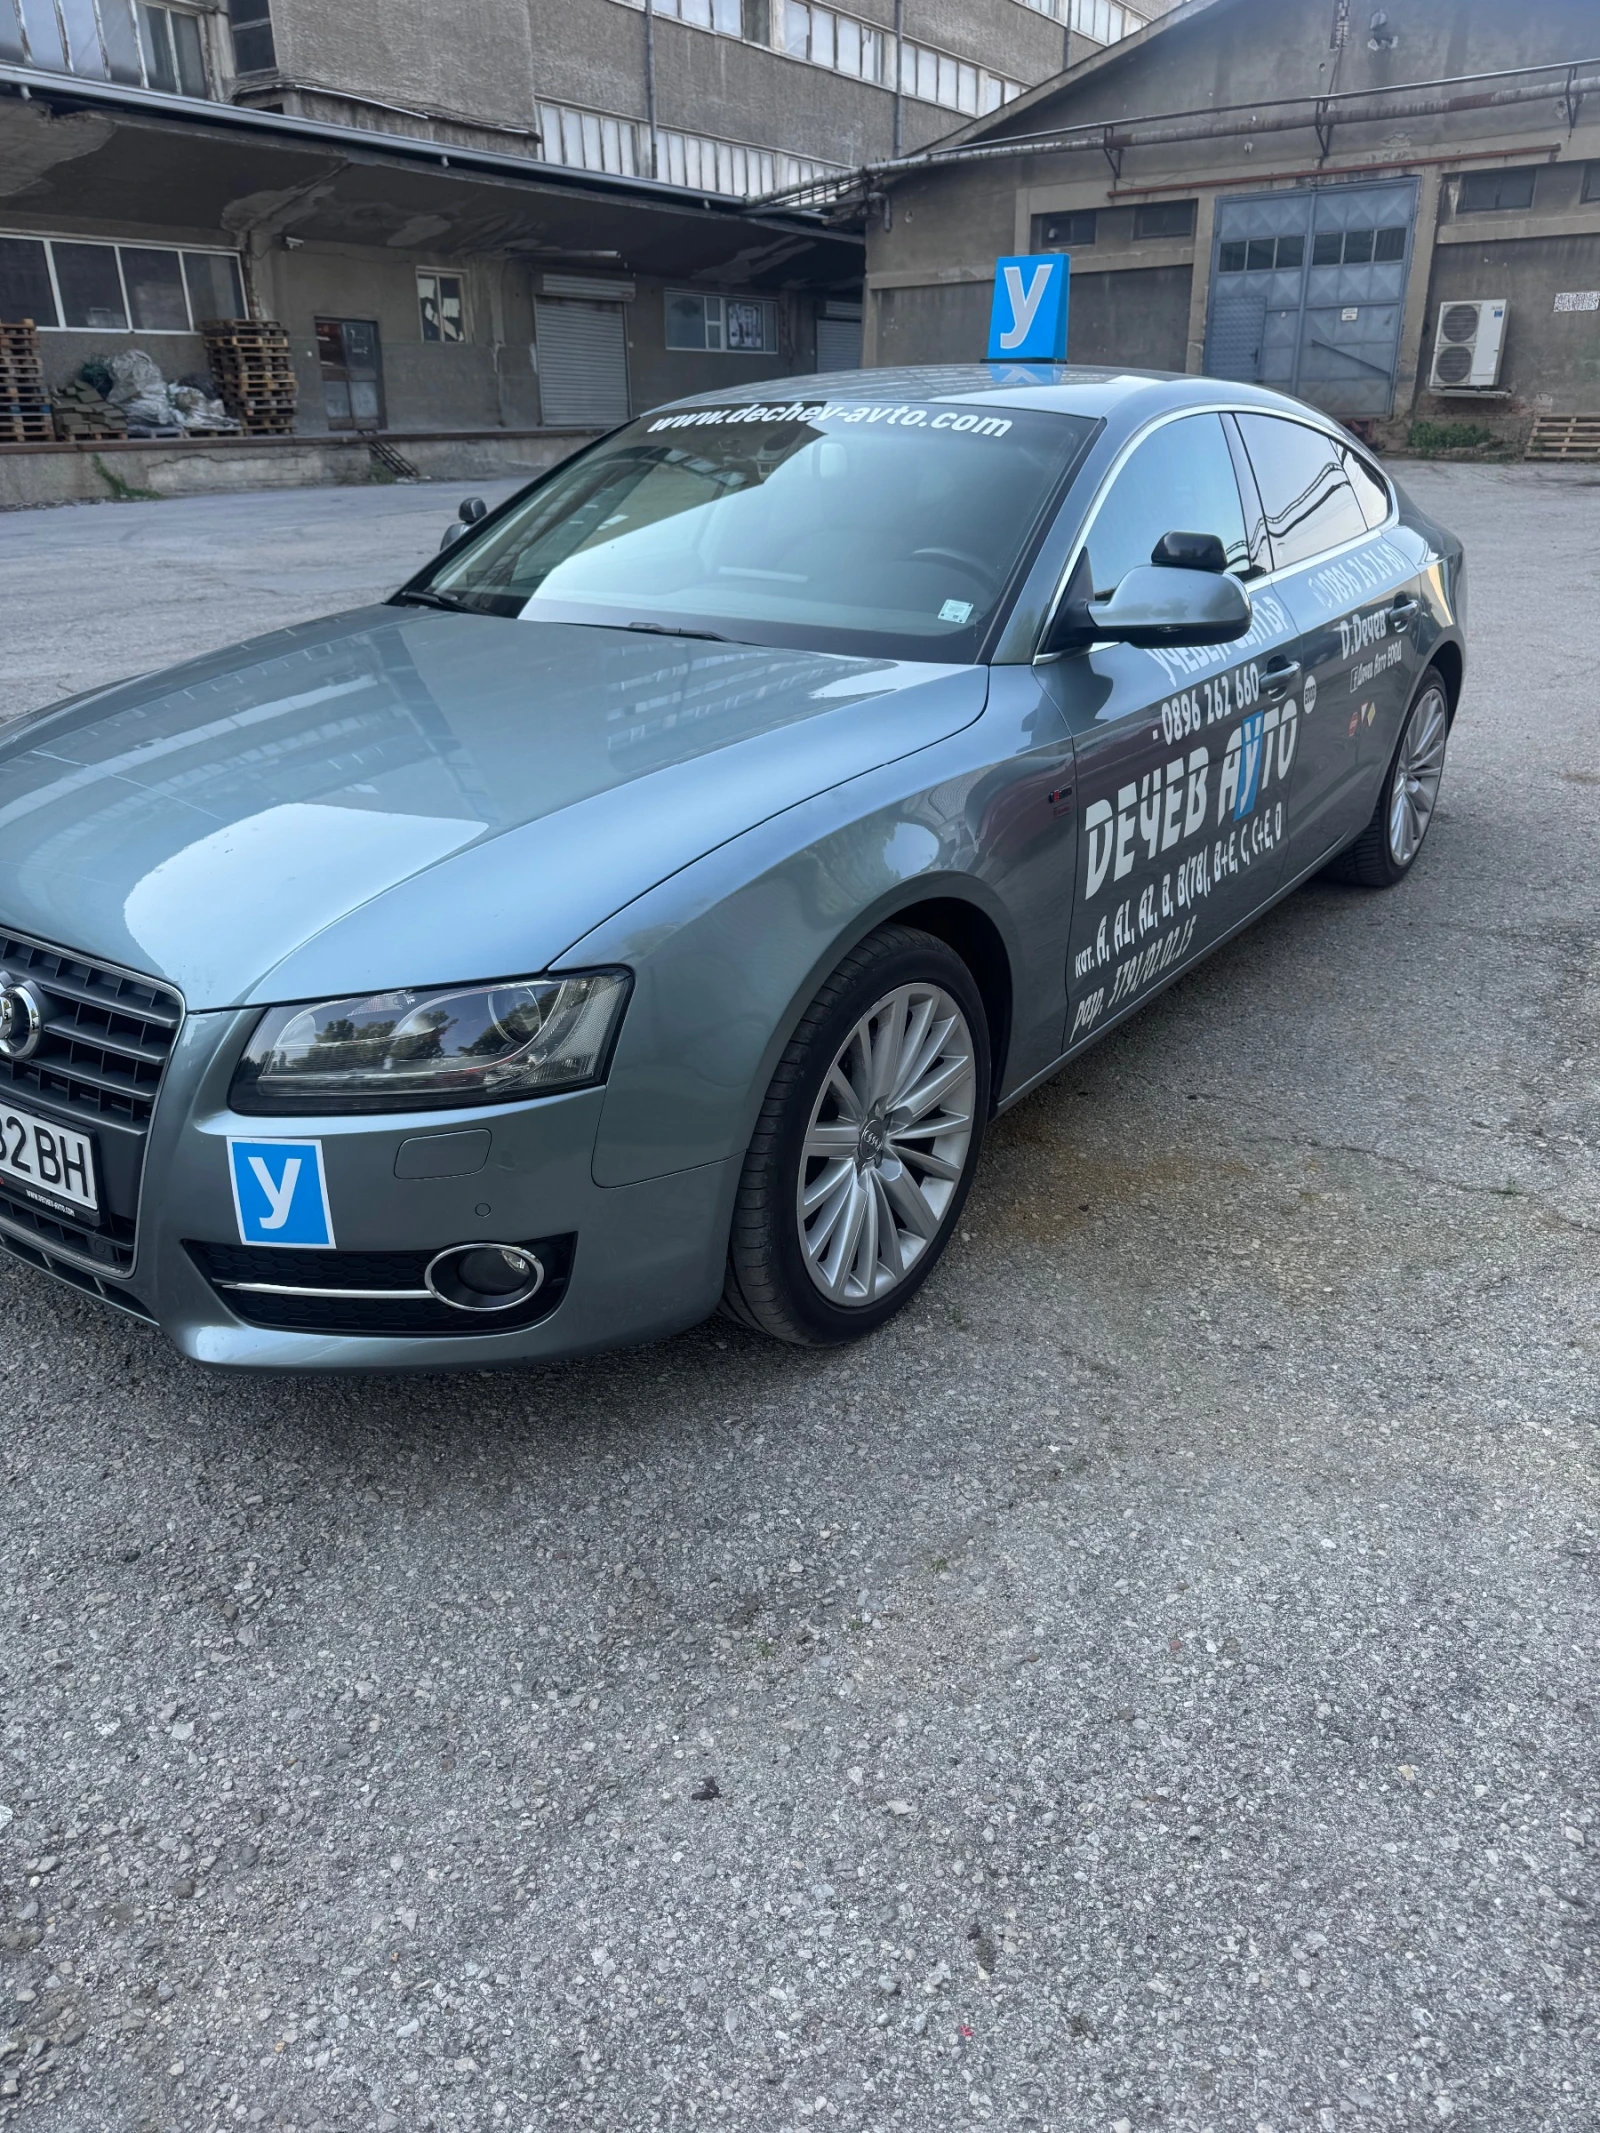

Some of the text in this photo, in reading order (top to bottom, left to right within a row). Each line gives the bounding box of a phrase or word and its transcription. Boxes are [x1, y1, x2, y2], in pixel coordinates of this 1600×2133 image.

[648, 402, 1013, 437] www.dechev-avto.com
[1318, 544, 1406, 603] 0896 26 26 60
[1161, 690, 1201, 745] 0896
[1204, 676, 1231, 725] 262
[1236, 663, 1259, 709] 660
[0, 1115, 90, 1199] 2BH
